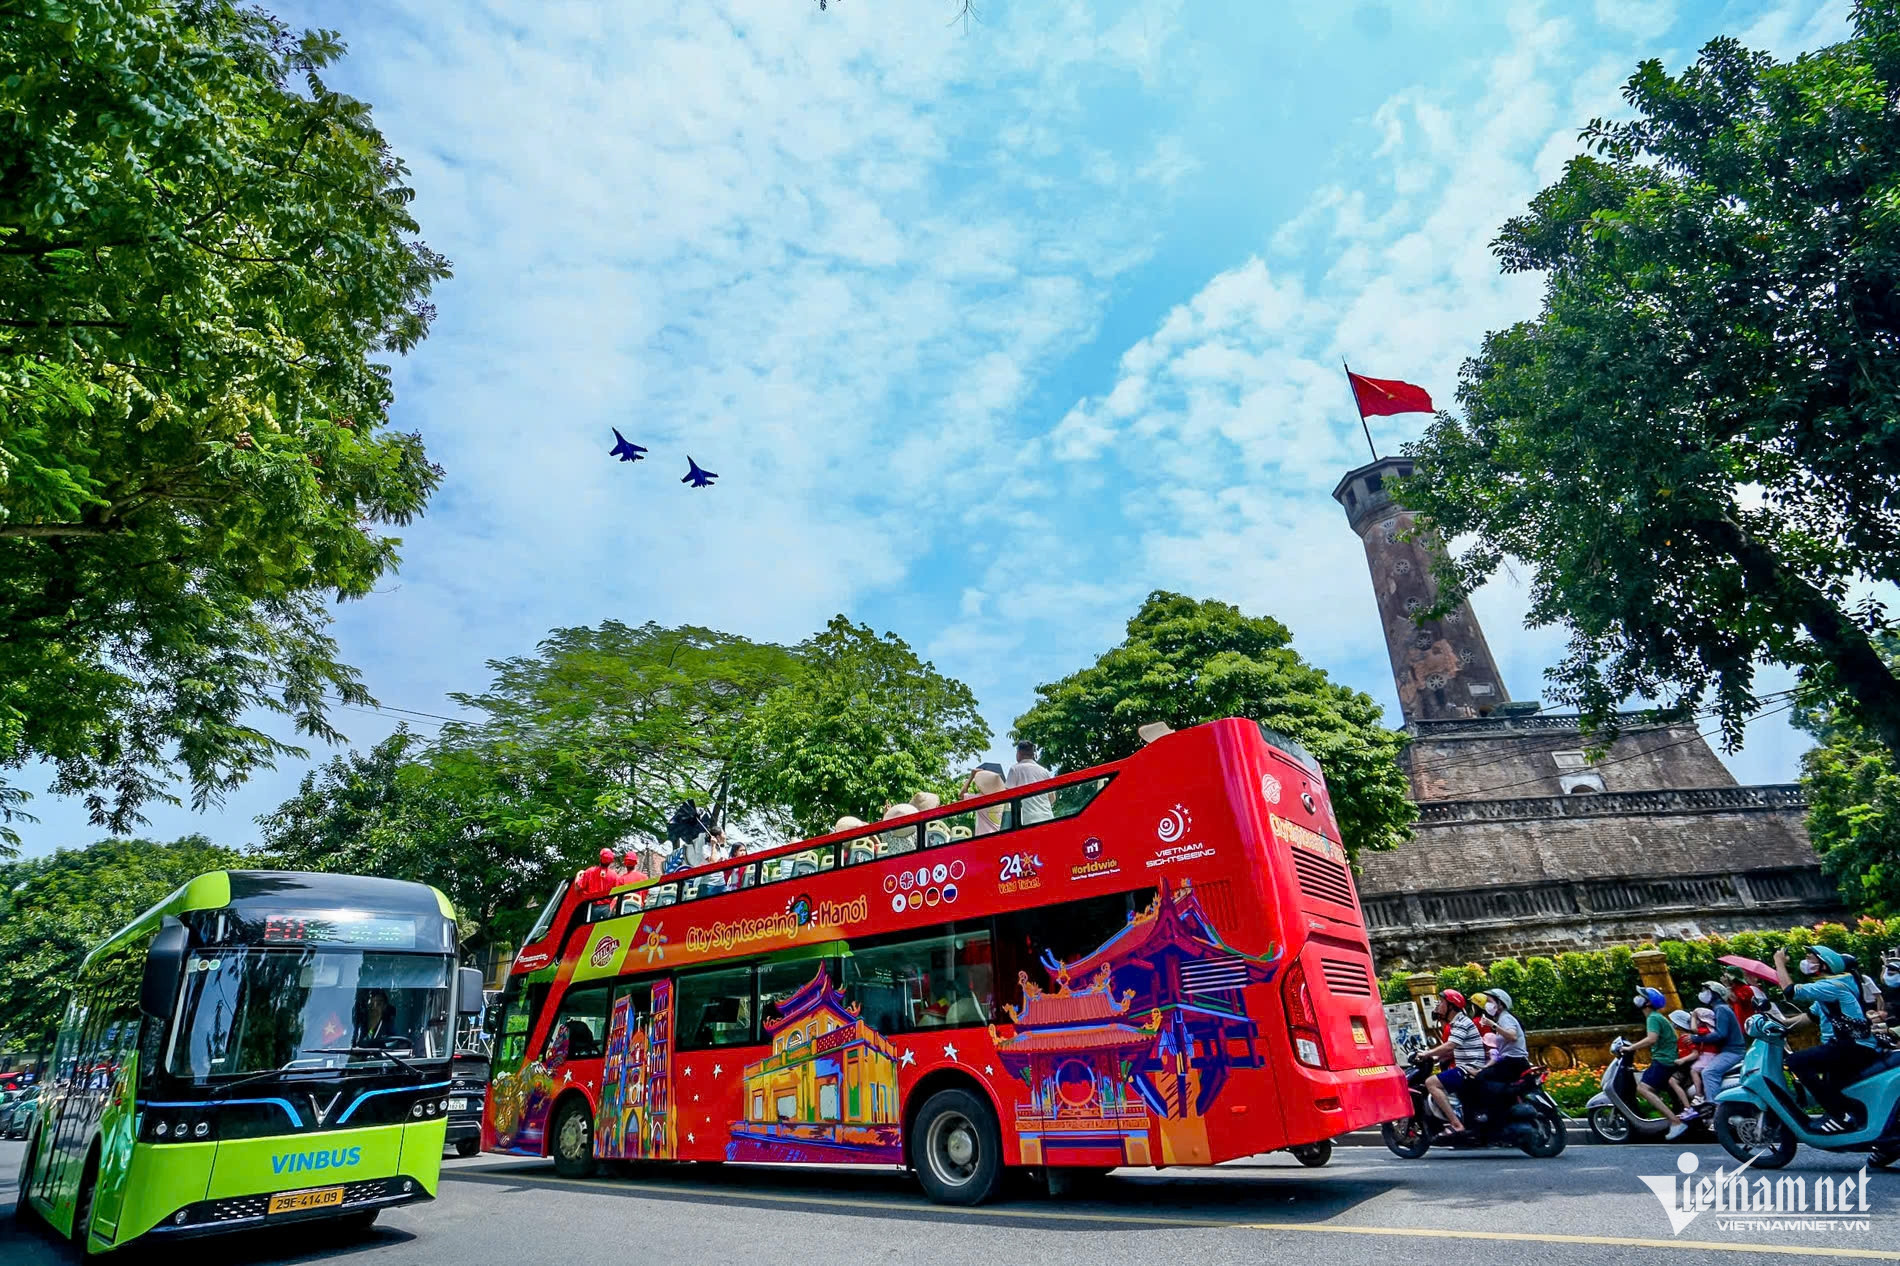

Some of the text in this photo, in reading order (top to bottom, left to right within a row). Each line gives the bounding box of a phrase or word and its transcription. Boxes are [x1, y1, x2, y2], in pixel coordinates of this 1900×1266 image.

[1145, 848, 1216, 868] SIGHTSEEING
[1155, 842, 1203, 858] VIETNAM
[1000, 854, 1022, 881] 24
[819, 894, 868, 928] Hanoi
[592, 940, 619, 965] OFFICIAL
[271, 1146, 362, 1175] VINBUS
[275, 1191, 338, 1211] 29E-414.09
